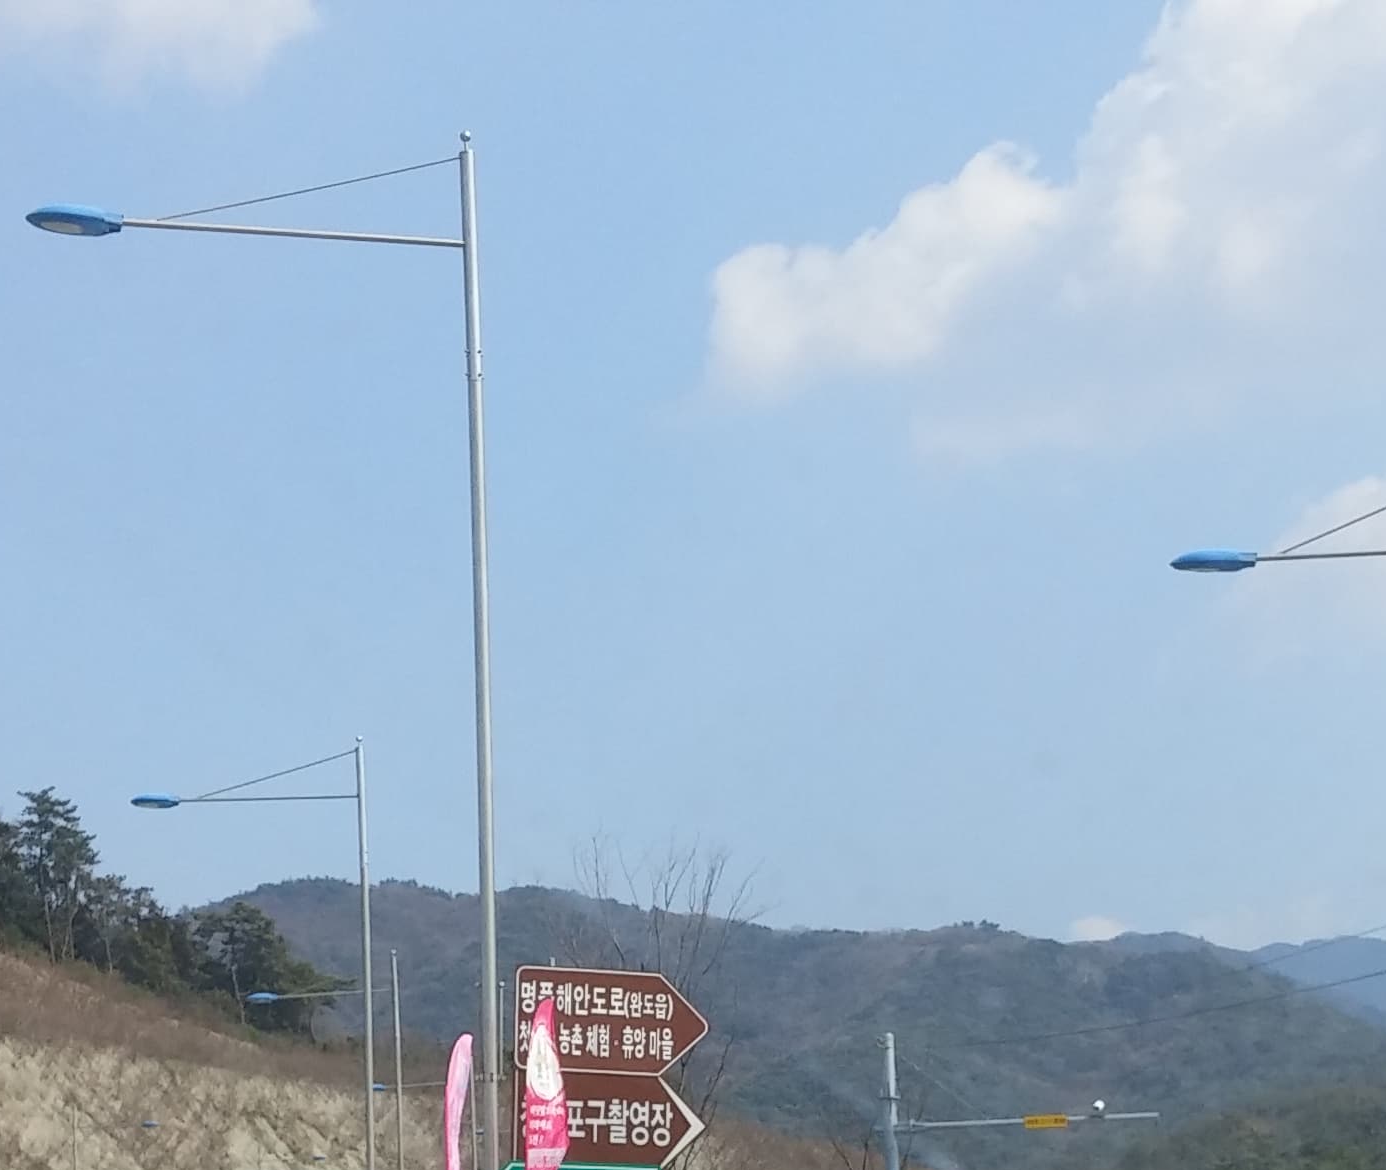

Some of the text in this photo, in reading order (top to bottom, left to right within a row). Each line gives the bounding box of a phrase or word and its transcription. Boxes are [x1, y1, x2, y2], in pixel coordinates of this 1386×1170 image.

[558, 1022, 583, 1056] 농촌
[586, 1024, 610, 1058] 체험
[622, 1025, 646, 1060] 휴양
[649, 1027, 674, 1061] 마을
[520, 1098, 673, 1147] 포구촬영장
